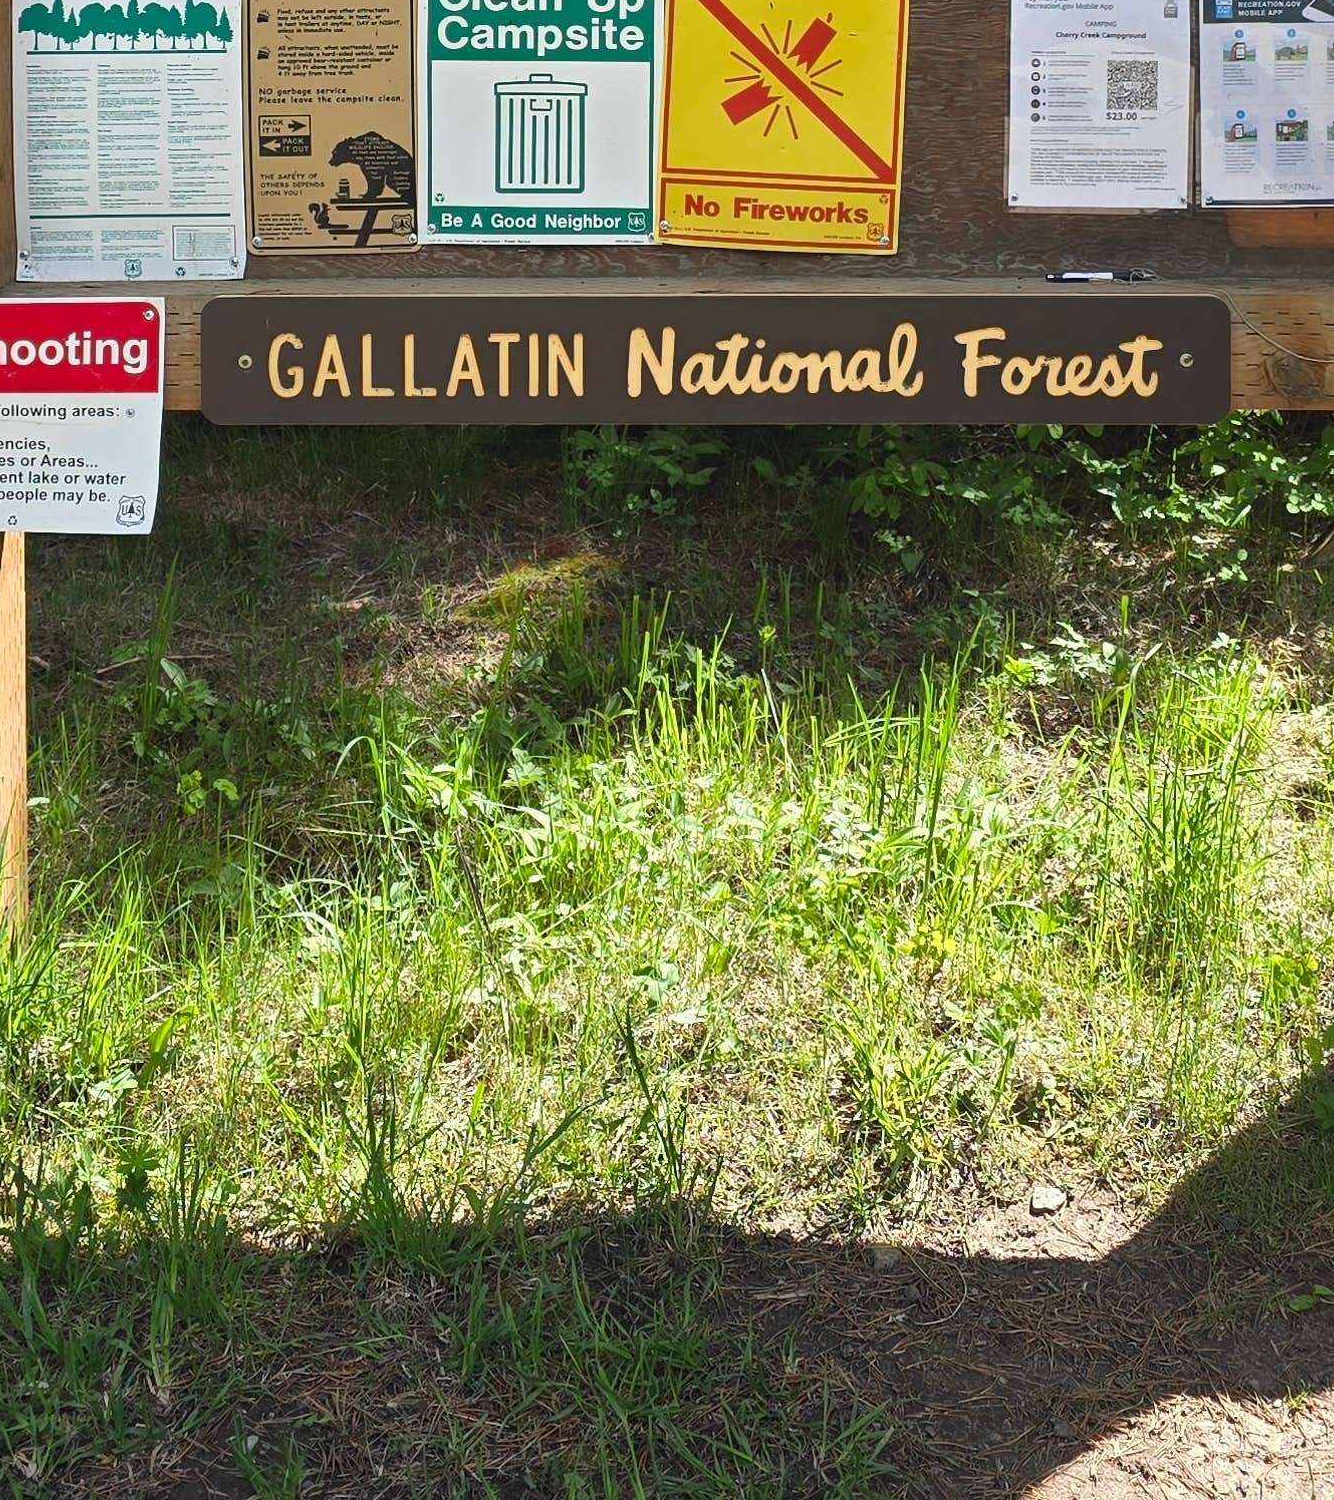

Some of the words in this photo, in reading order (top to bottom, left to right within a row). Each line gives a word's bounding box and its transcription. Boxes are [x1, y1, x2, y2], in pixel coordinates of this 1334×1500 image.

[437, 17, 645, 56] Campsite
[277, 88, 311, 96] garbage
[1106, 112, 1137, 121] $23.00
[684, 194, 720, 218] No
[733, 197, 869, 224] Fireworks
[441, 213, 463, 228] Be
[472, 214, 483, 228] A
[491, 214, 537, 229] Good
[544, 214, 621, 231] Neighbor
[268, 332, 585, 399] GALLATIN
[627, 322, 924, 398] National
[954, 327, 1163, 398] Forest
[72, 406, 120, 417] areas:
[20, 456, 36, 467] or
[41, 455, 98, 468] Areas...
[28, 472, 59, 484] lake
[64, 474, 80, 484] or
[85, 474, 126, 485] water
[52, 491, 84, 504] may
[89, 490, 110, 502] be.
